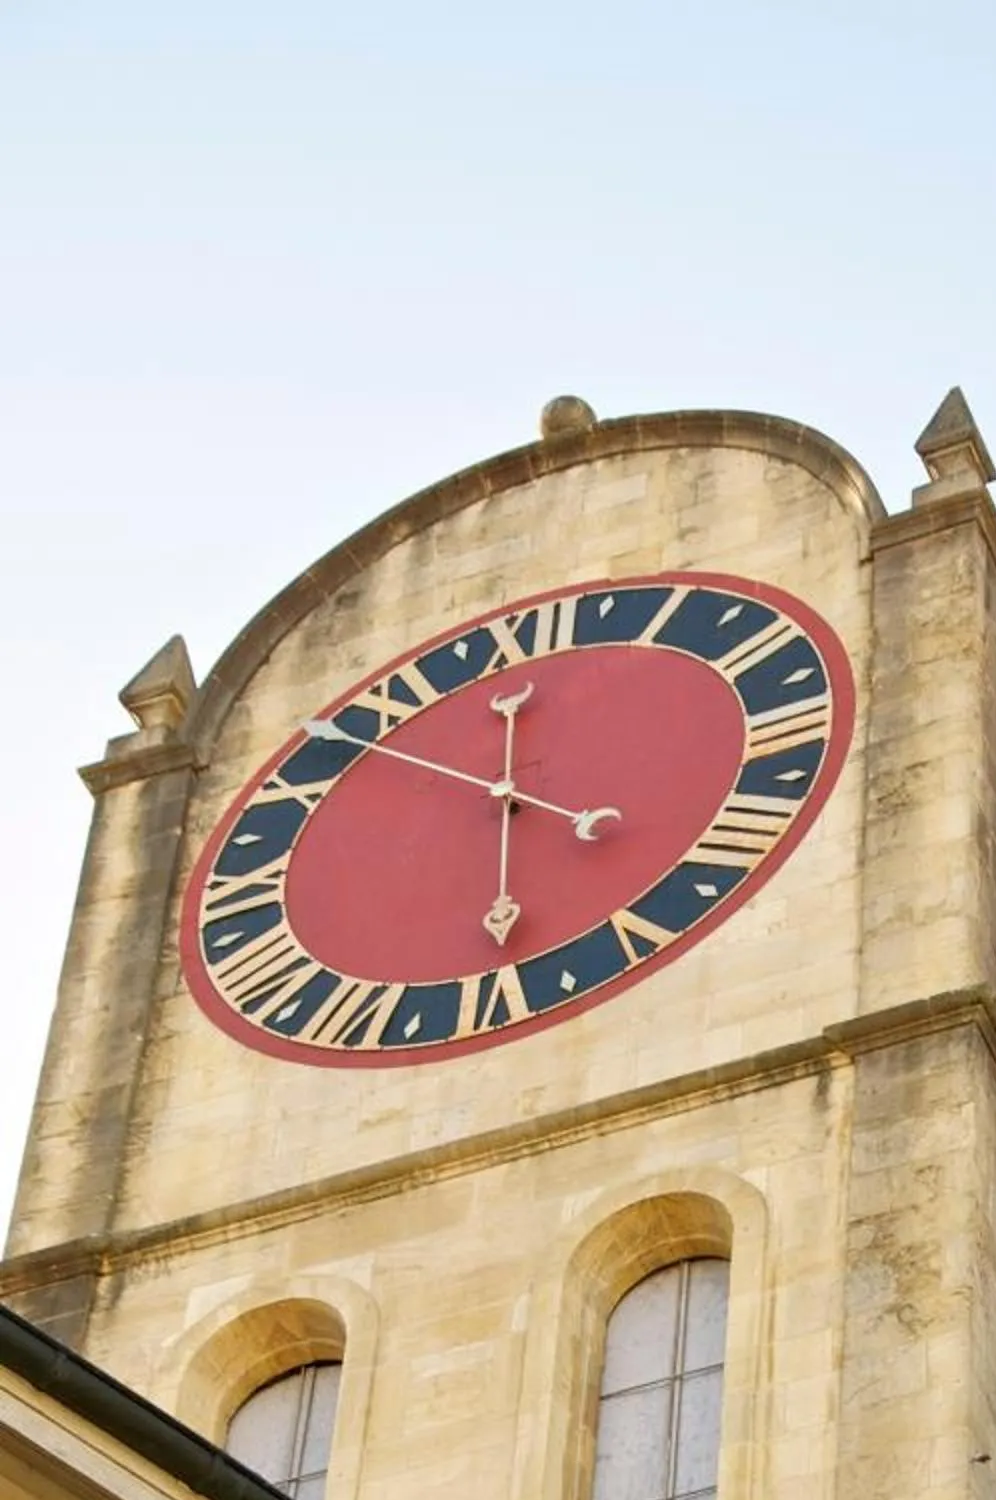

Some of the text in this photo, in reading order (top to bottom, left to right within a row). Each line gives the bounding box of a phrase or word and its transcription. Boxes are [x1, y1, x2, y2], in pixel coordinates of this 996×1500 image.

[477, 598, 577, 679] XII
[714, 614, 805, 680] II
[350, 664, 444, 739] XI
[746, 693, 830, 762] III
[243, 772, 336, 815] X
[683, 793, 804, 870] IIII
[202, 850, 291, 923] IX
[211, 920, 326, 1024] VIII
[610, 908, 683, 966] V
[297, 977, 407, 1049] VII
[455, 964, 536, 1039] VI
